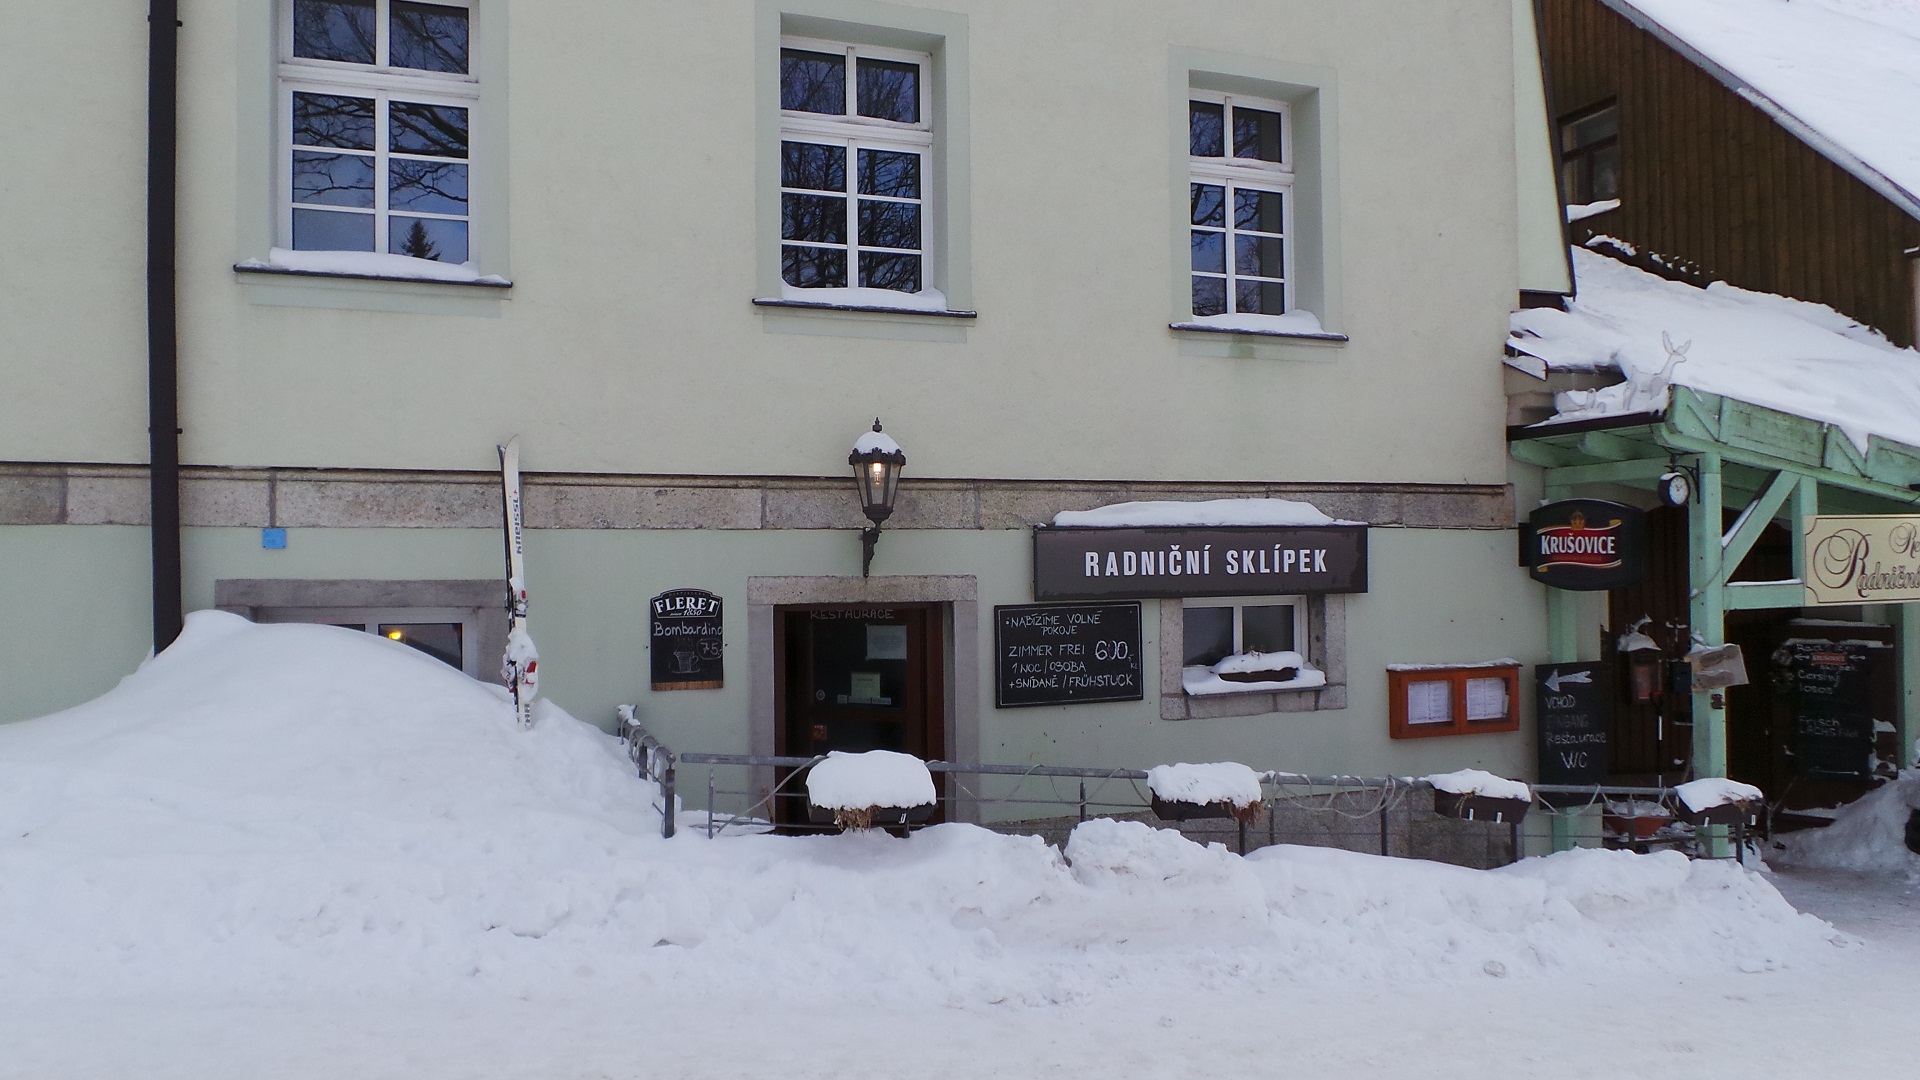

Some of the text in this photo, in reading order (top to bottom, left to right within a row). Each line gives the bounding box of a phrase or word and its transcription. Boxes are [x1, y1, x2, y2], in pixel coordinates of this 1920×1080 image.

[1541, 533, 1616, 555] KRUŠOVICE
[1085, 543, 1327, 577] RADNIČNÍ SKLÍPEK
[655, 597, 718, 613] FLERET
[811, 609, 895, 620] RESTAURACE
[1010, 610, 1102, 628] NABÍZÍME VOLNÉ
[653, 621, 722, 636] Bombardino
[1041, 625, 1077, 636] POKOJE
[1008, 644, 1052, 657] ZIMMER
[1059, 644, 1085, 656] FREI
[1545, 694, 1576, 709] VCHOD
[1546, 731, 1606, 747] Restaurace
[1560, 751, 1588, 769] WC
